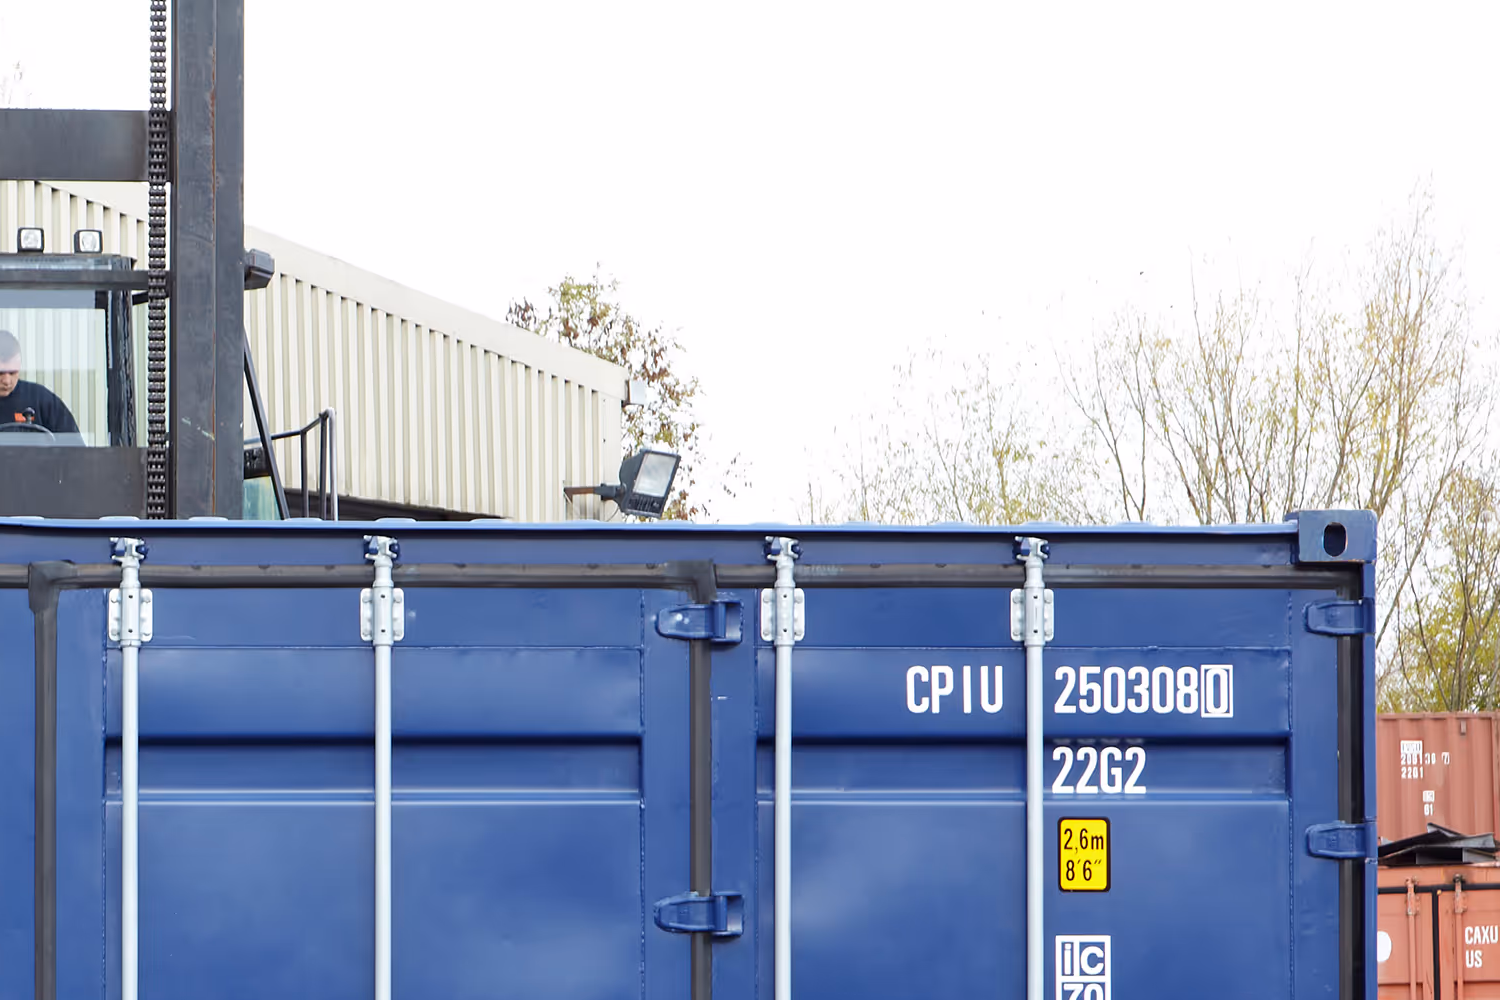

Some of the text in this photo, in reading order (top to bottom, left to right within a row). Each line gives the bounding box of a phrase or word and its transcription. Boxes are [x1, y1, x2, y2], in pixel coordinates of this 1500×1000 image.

[906, 665, 1004, 714] CPIU
[1052, 746, 1147, 794] 22G2
[1464, 925, 1499, 945] CAXU
[1465, 949, 1483, 968] US
